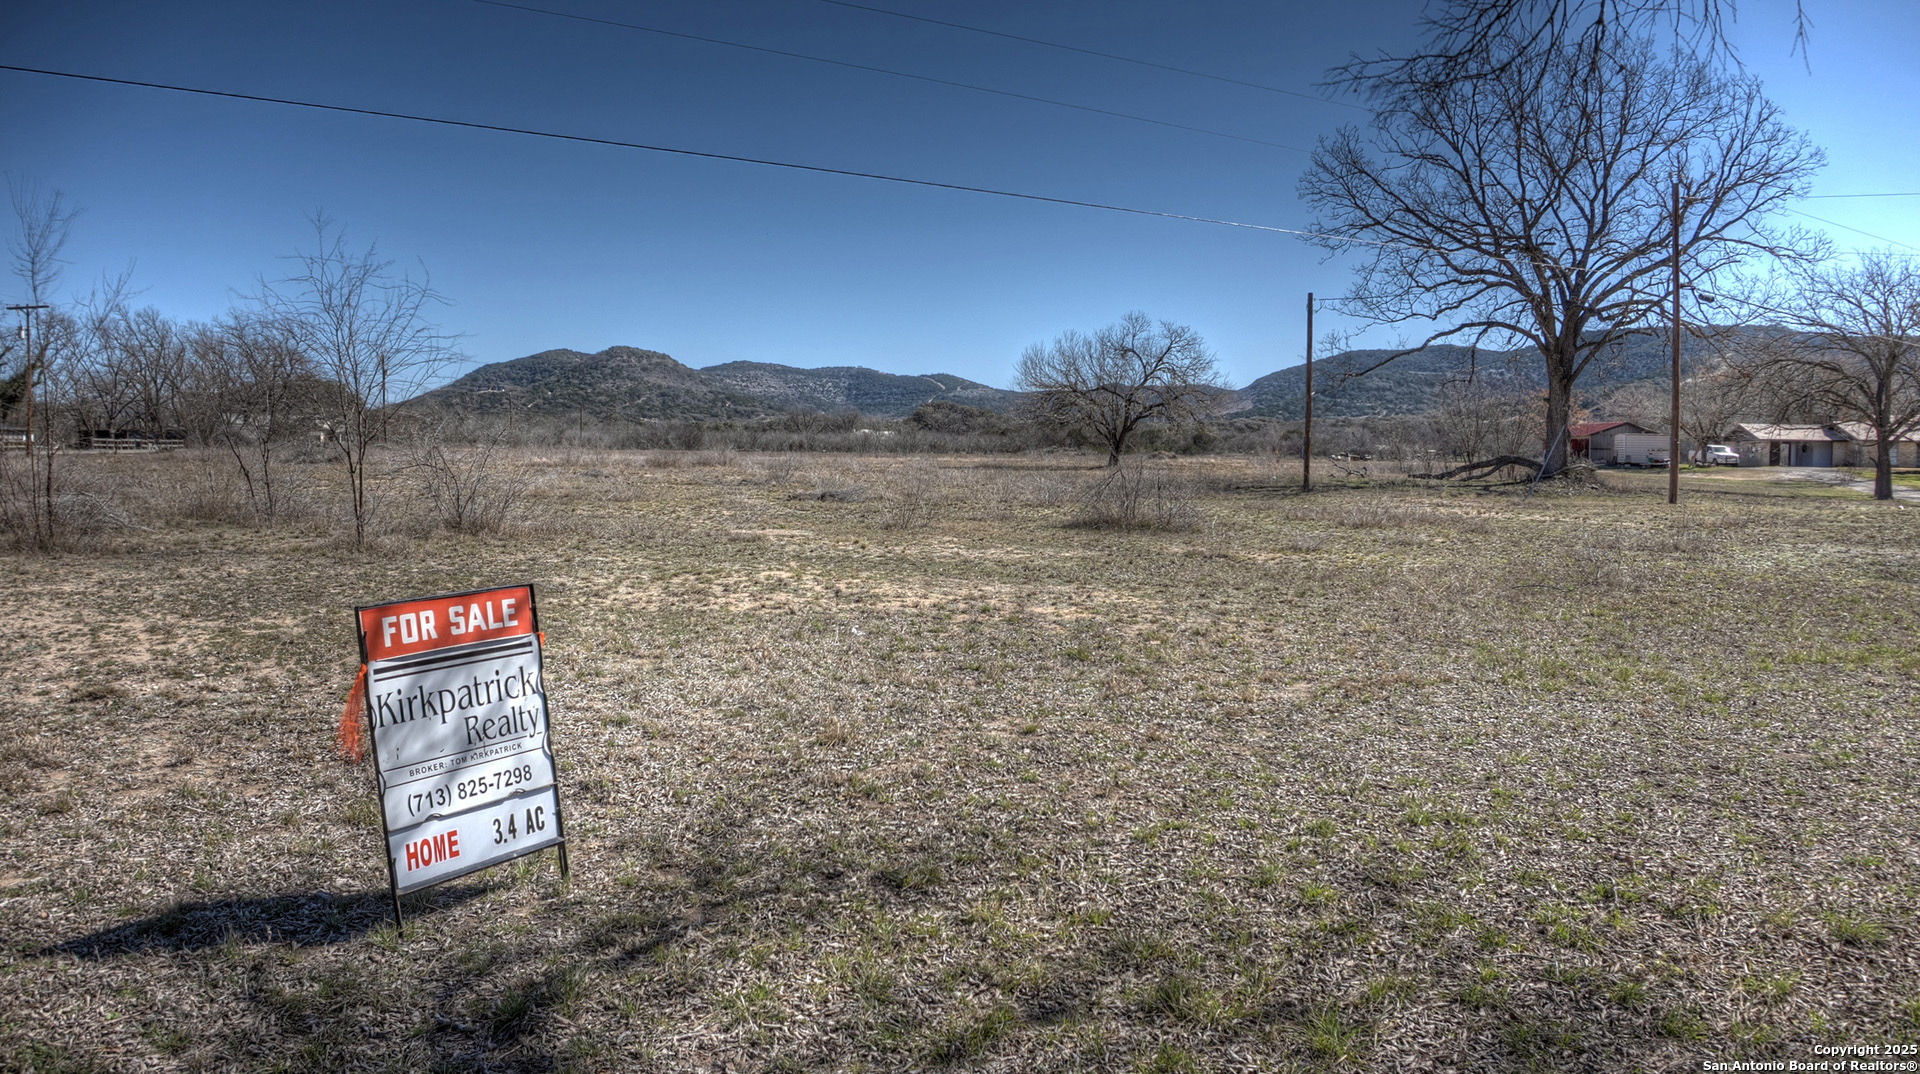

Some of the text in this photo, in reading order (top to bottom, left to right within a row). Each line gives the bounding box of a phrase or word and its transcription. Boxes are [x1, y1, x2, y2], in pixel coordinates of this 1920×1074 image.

[381, 598, 519, 648] FOR SALE
[375, 665, 537, 728] Kirkpatrick
[464, 705, 540, 746] Realty
[409, 743, 523, 777] BROKER: TOM KIRKPATRICK
[407, 764, 533, 817] (713) 825-7298
[405, 805, 546, 872] HOME 3.4 AC
